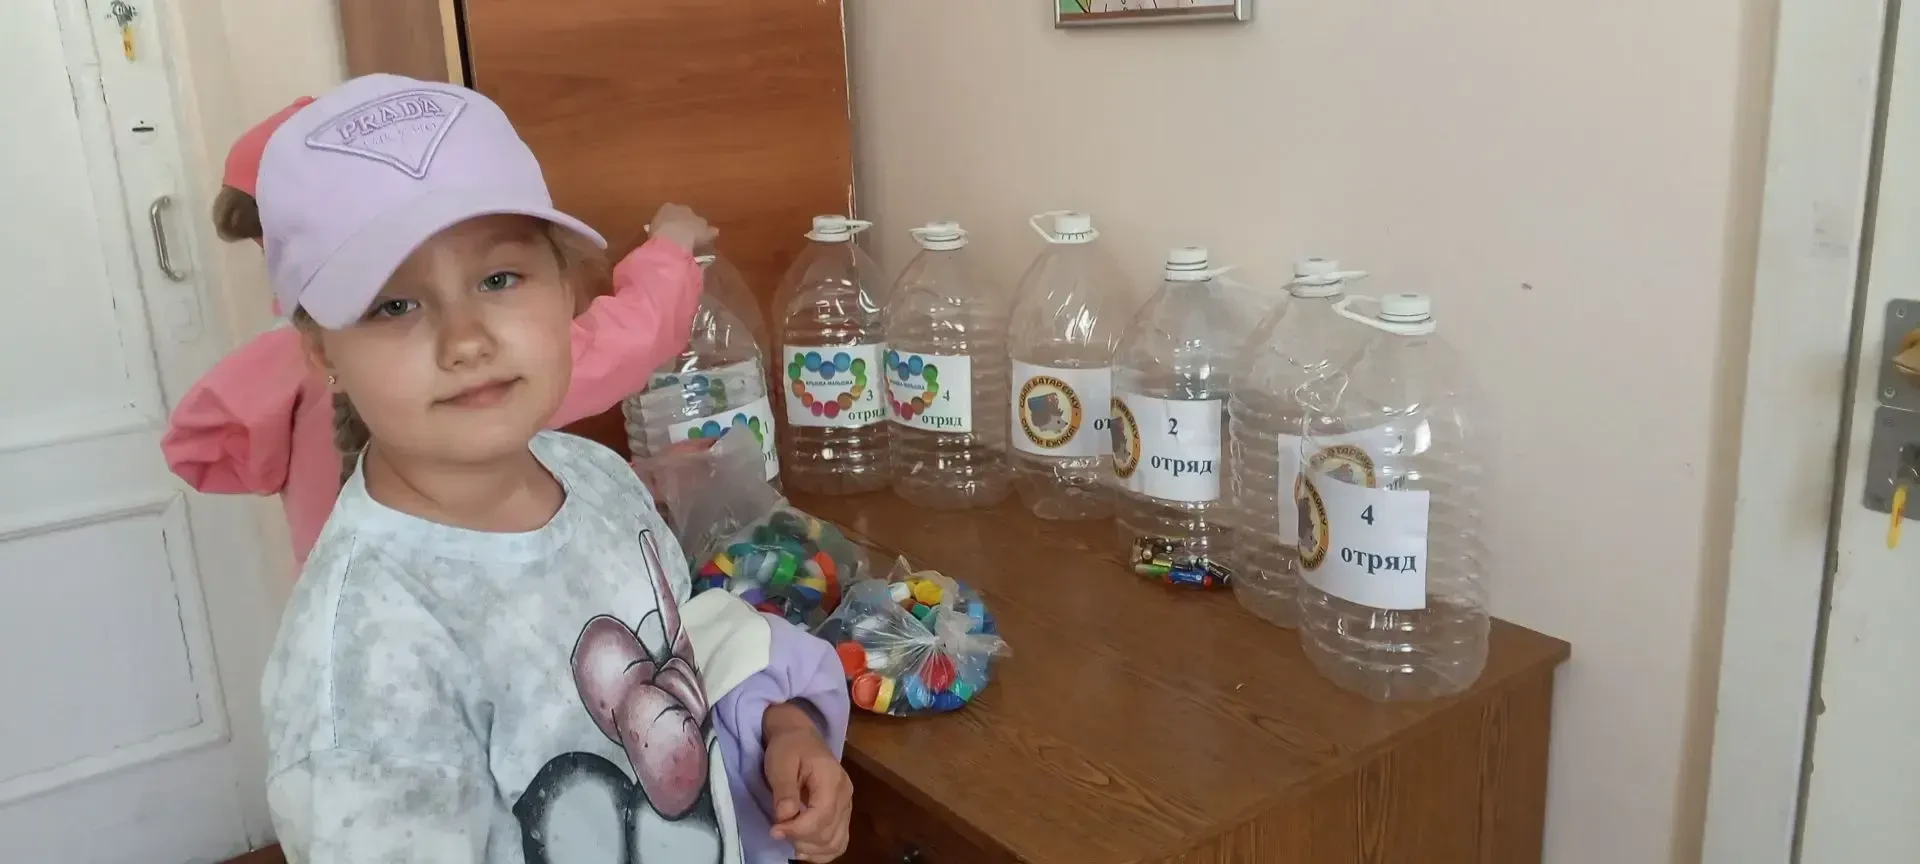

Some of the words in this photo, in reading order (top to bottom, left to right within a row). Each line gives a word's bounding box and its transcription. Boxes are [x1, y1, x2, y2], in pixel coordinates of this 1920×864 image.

[337, 97, 446, 145] PRADA
[866, 389, 873, 401] 3
[943, 389, 950, 401] 4
[1032, 377, 1080, 409] БАТАРЕЙКУ
[848, 407, 886, 422] отряд
[922, 415, 963, 428] отряд
[1168, 418, 1178, 435] 2
[1151, 455, 1213, 477] отряд
[1360, 504, 1375, 526] 4
[1341, 547, 1417, 575] отряд
